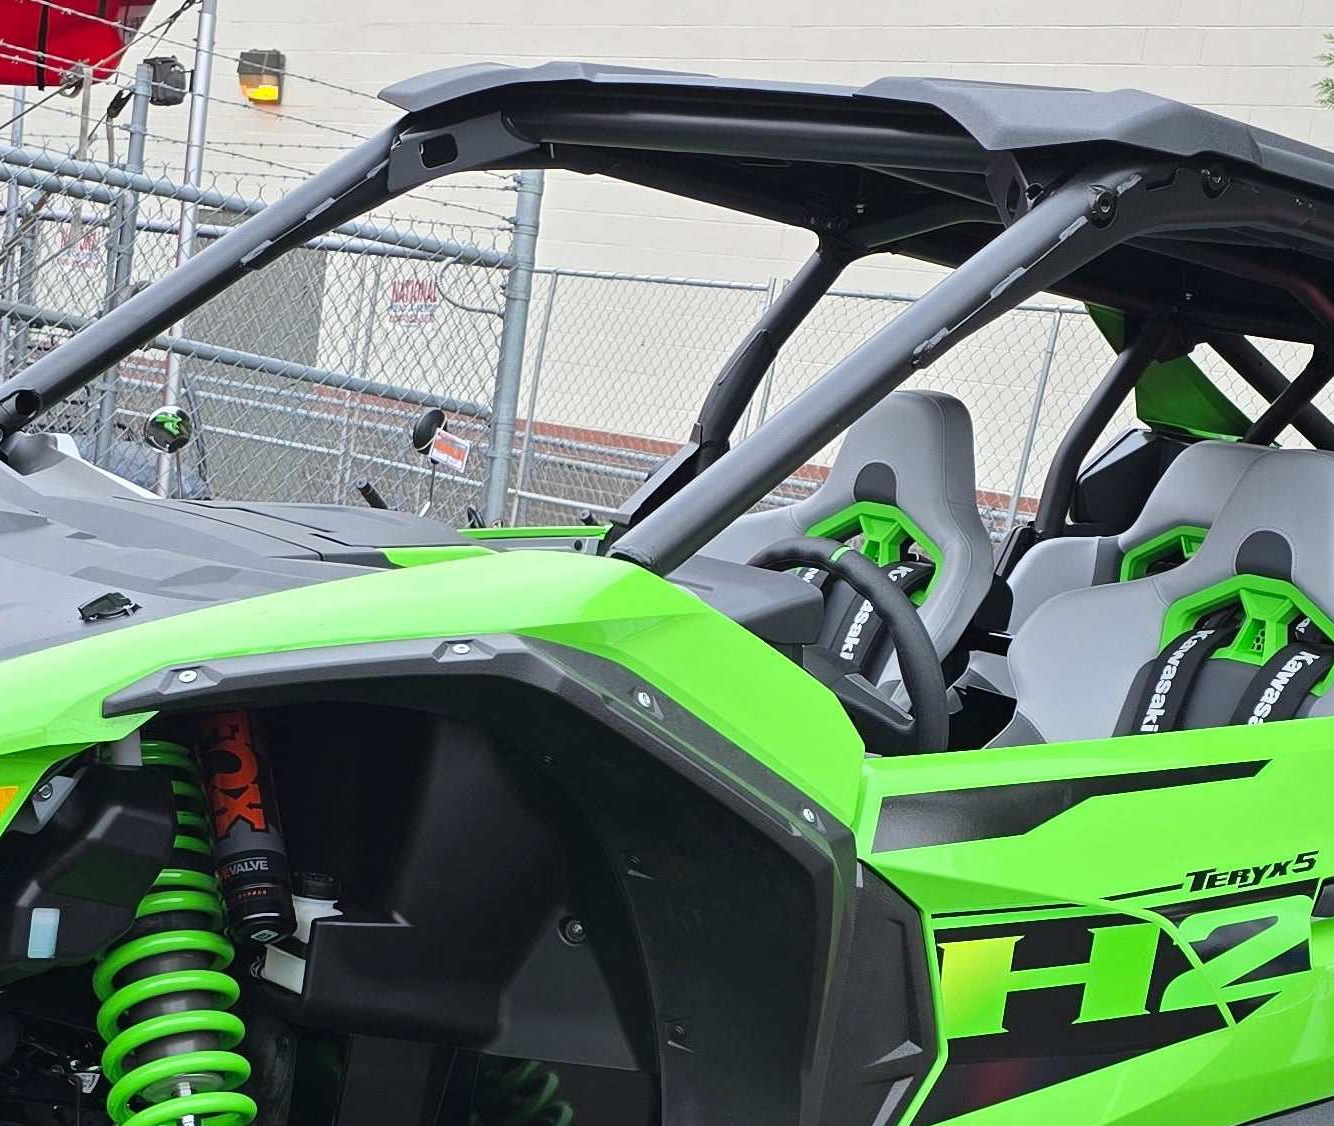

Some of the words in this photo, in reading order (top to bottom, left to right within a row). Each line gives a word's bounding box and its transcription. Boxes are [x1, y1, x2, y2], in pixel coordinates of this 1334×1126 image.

[1140, 629, 1216, 732] Kawasaki
[203, 709, 266, 838] FOX
[937, 894, 1313, 1040] H2
